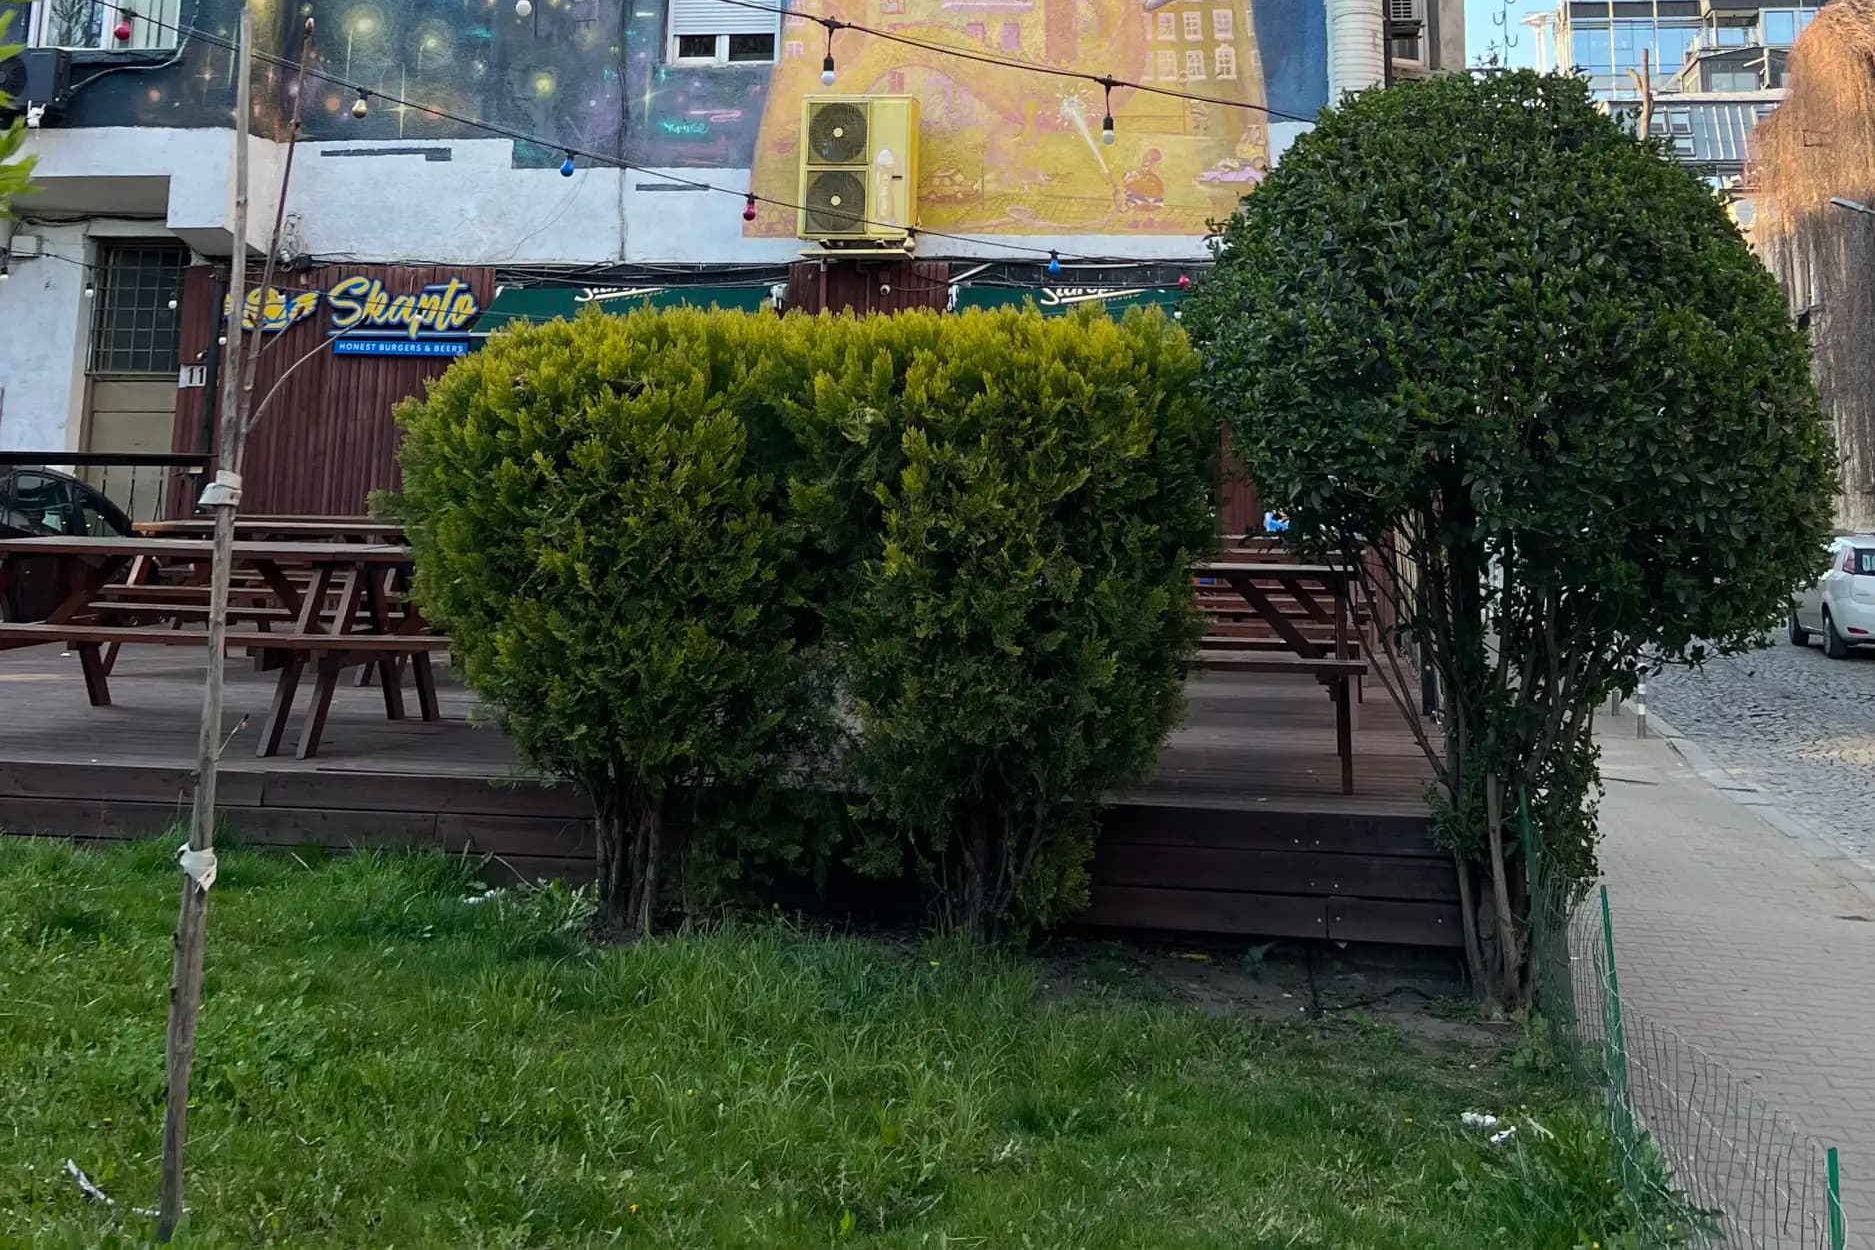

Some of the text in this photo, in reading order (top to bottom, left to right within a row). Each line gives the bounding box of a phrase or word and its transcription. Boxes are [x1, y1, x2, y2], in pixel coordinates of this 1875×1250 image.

[328, 276, 479, 339] Skapto
[338, 342, 464, 354] HONEST BURGERS & BEERS
